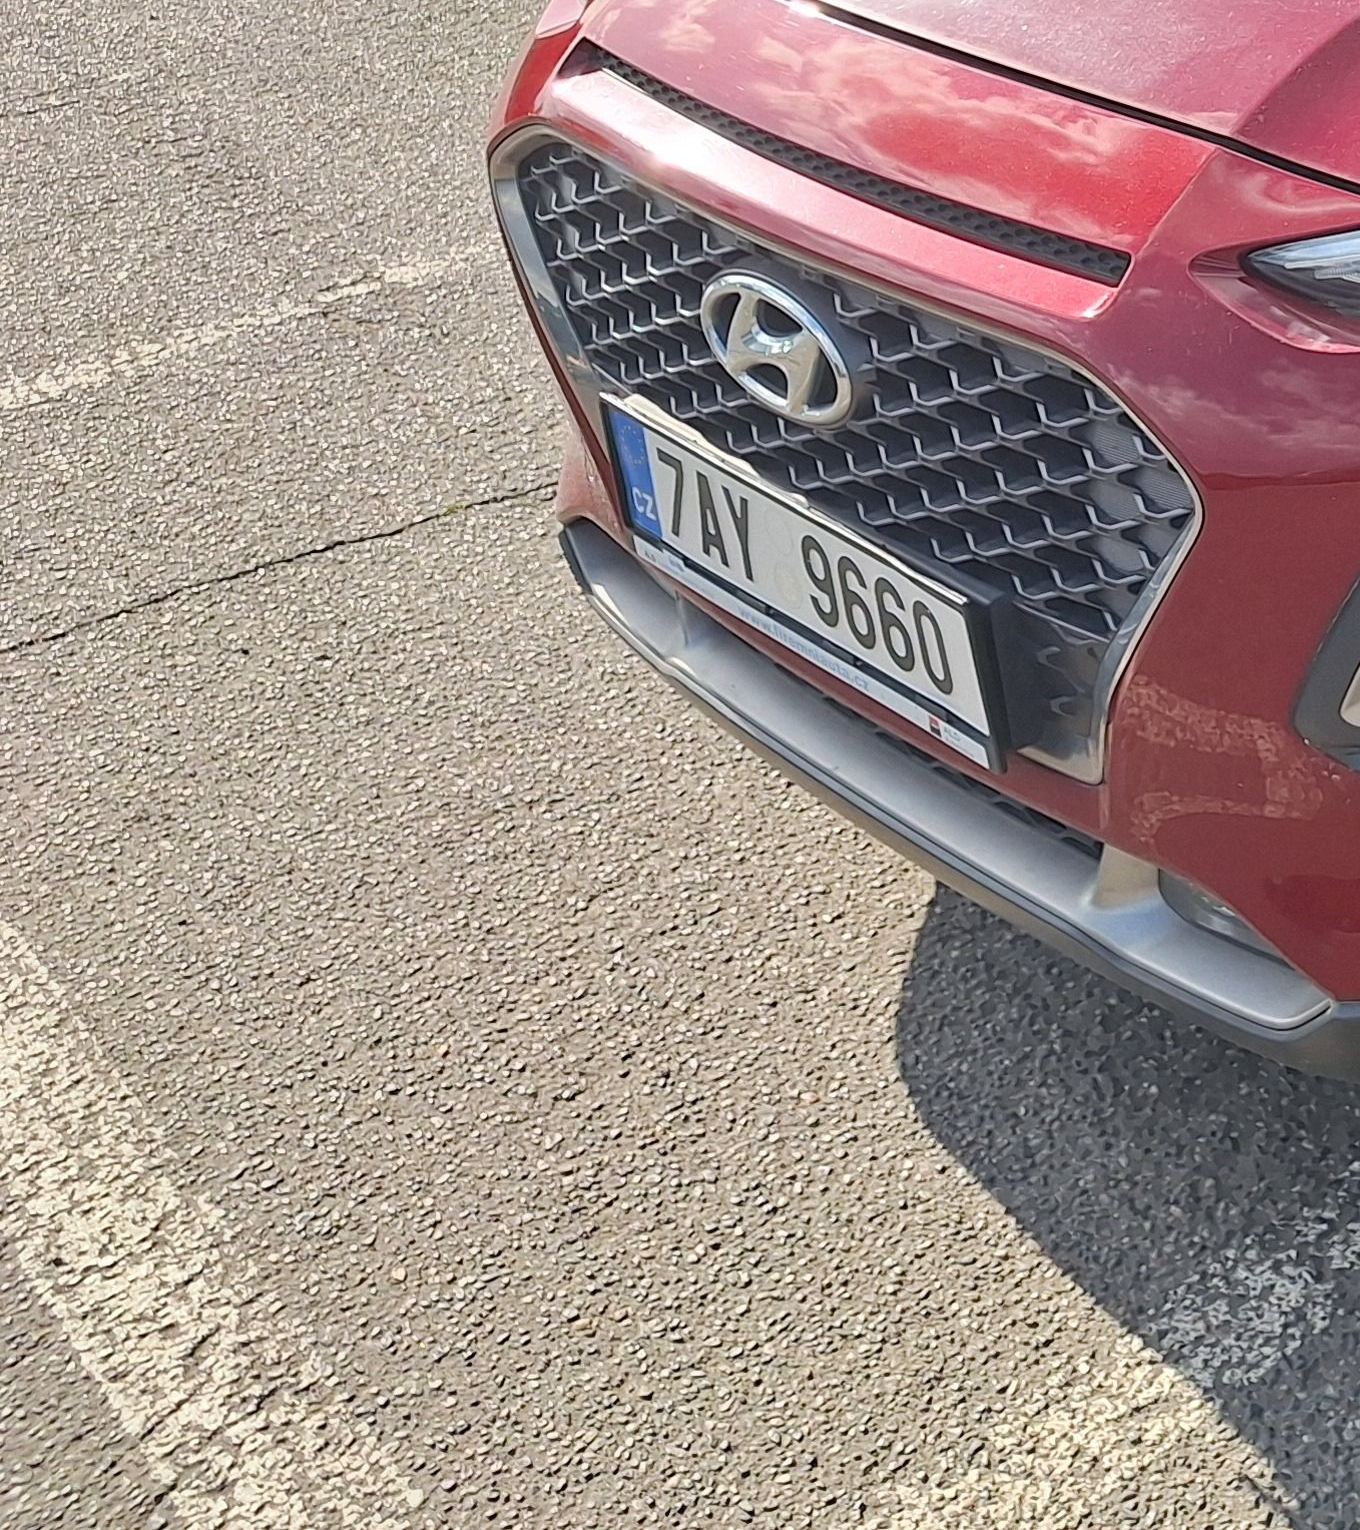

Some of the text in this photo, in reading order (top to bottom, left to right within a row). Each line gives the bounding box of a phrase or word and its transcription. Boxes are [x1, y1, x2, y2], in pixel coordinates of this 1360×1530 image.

[632, 486, 657, 521] CZ
[655, 446, 954, 696] 7AY 9660
